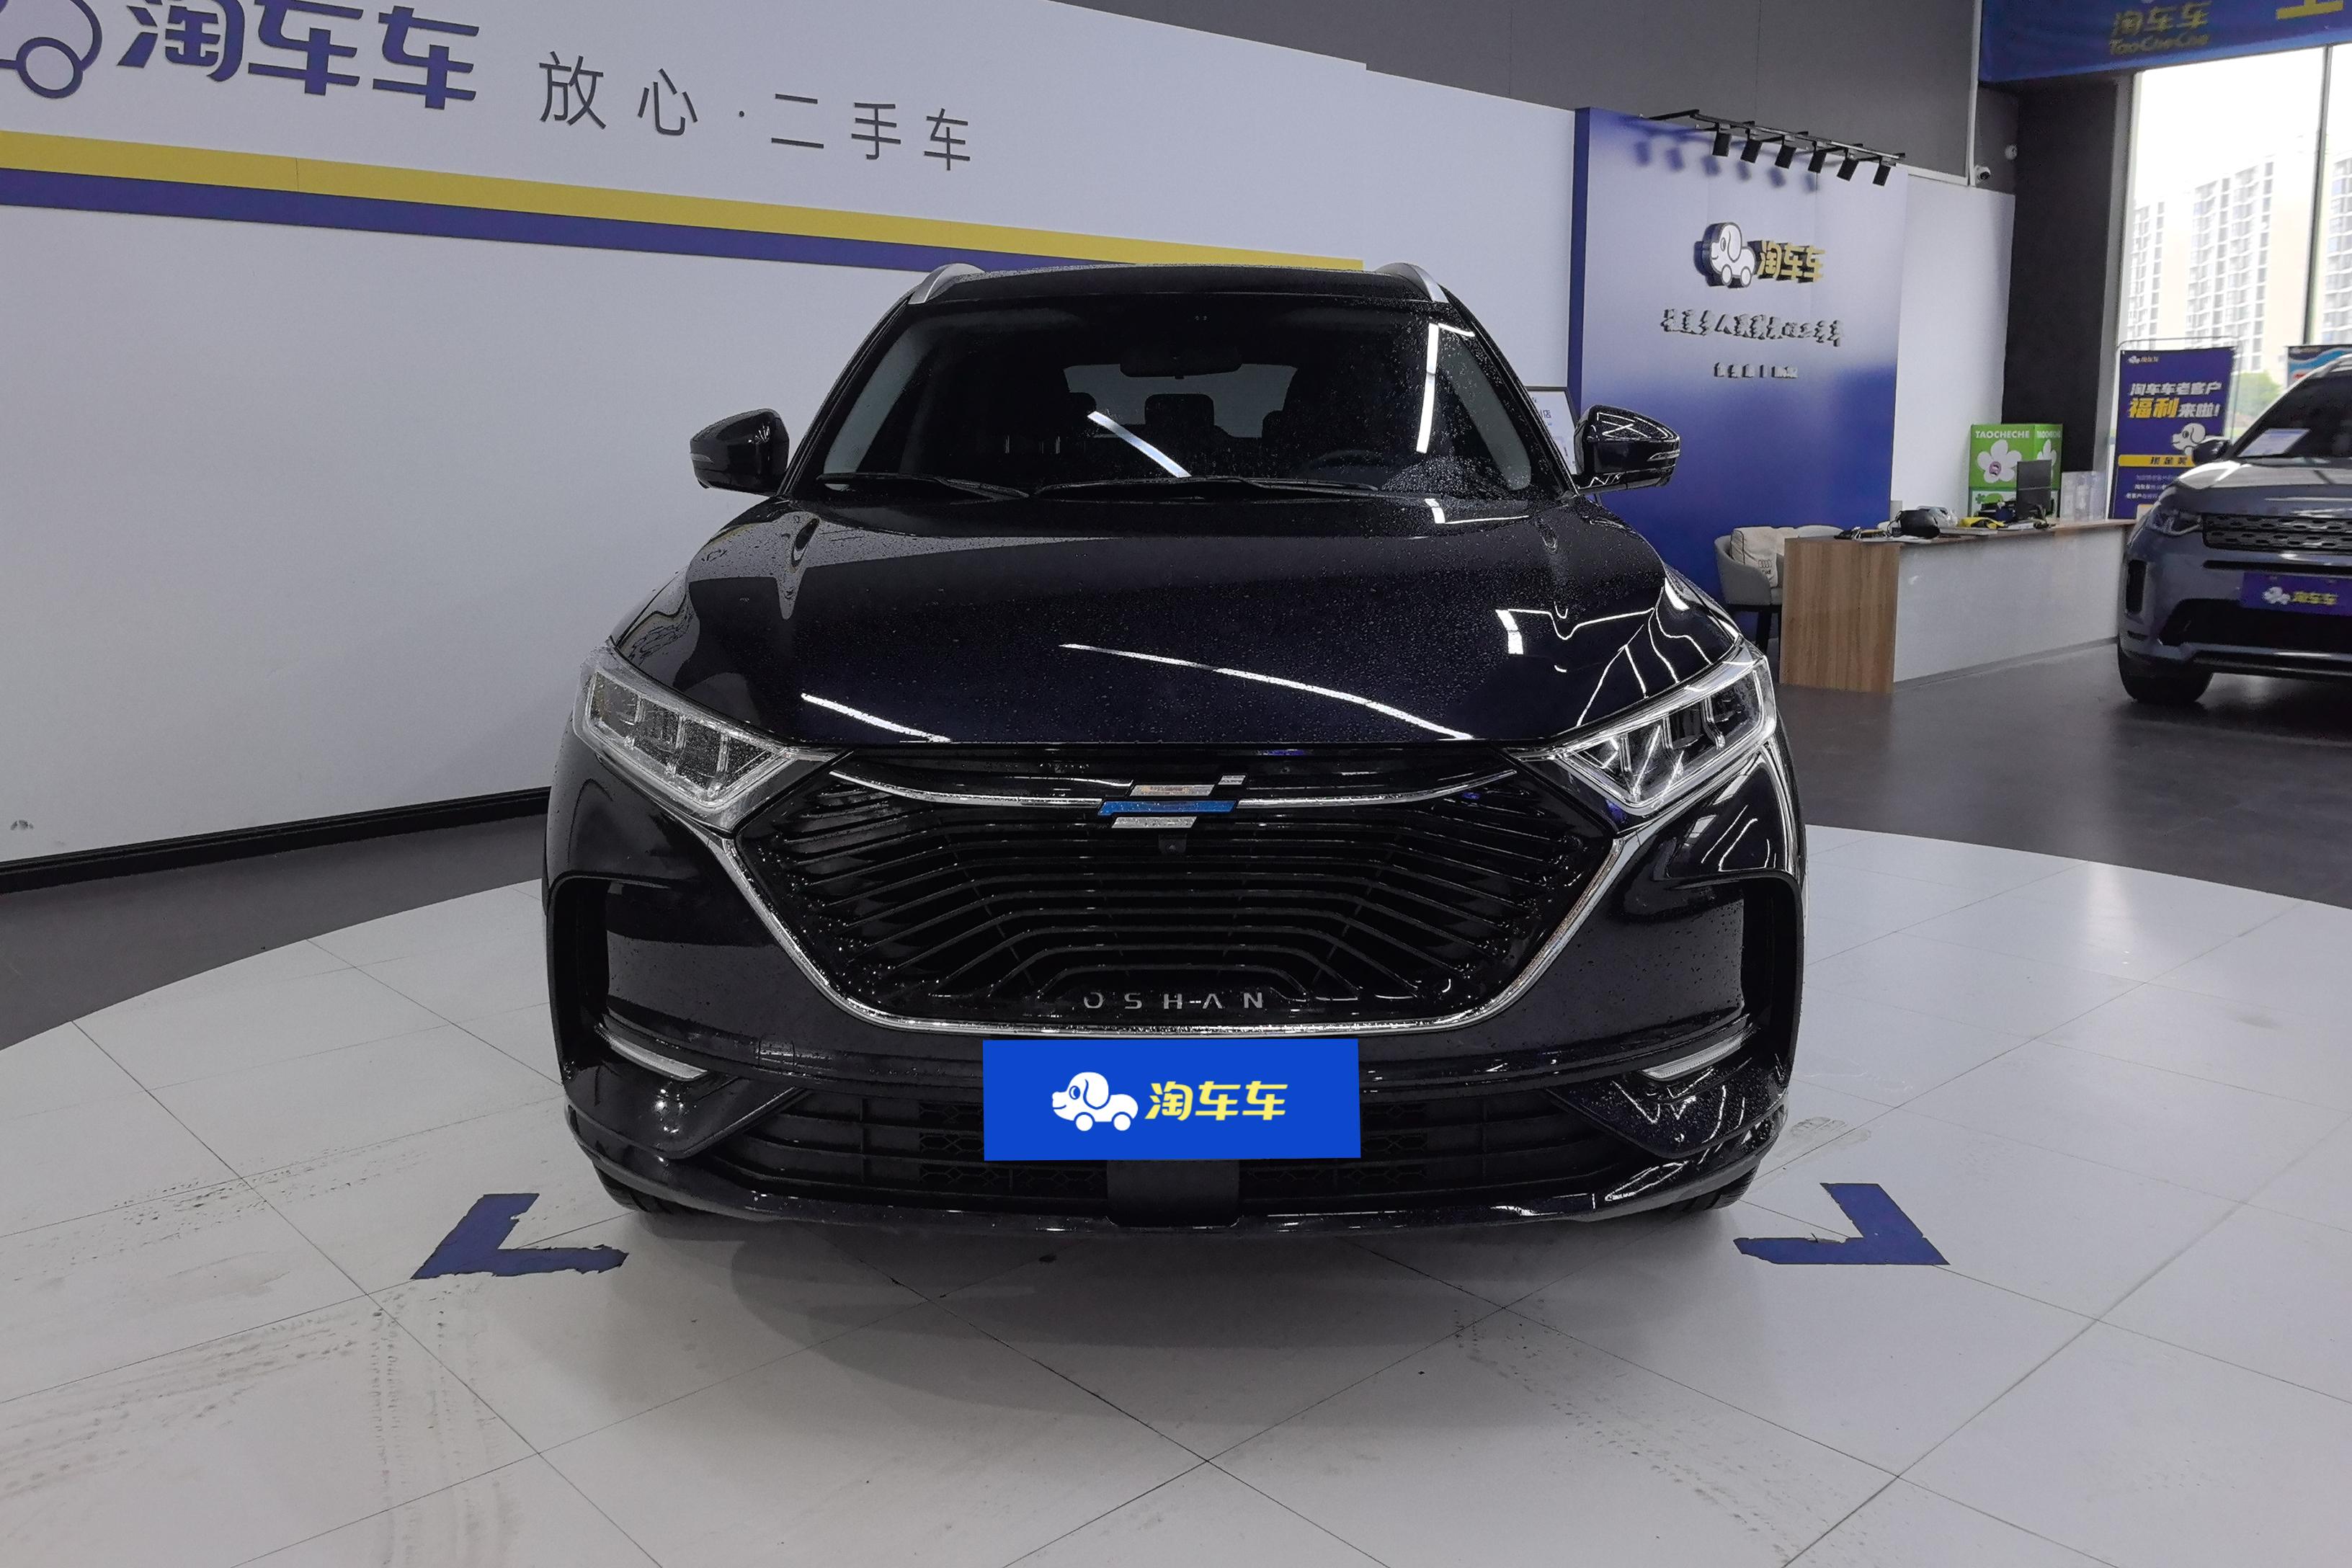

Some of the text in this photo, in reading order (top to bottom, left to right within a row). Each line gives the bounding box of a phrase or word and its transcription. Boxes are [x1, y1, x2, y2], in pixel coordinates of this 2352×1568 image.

[1751, 239, 1827, 283] 淘车车
[2129, 381, 2222, 396] 淘车车老客户
[1083, 991, 1264, 1010] OSHAN
